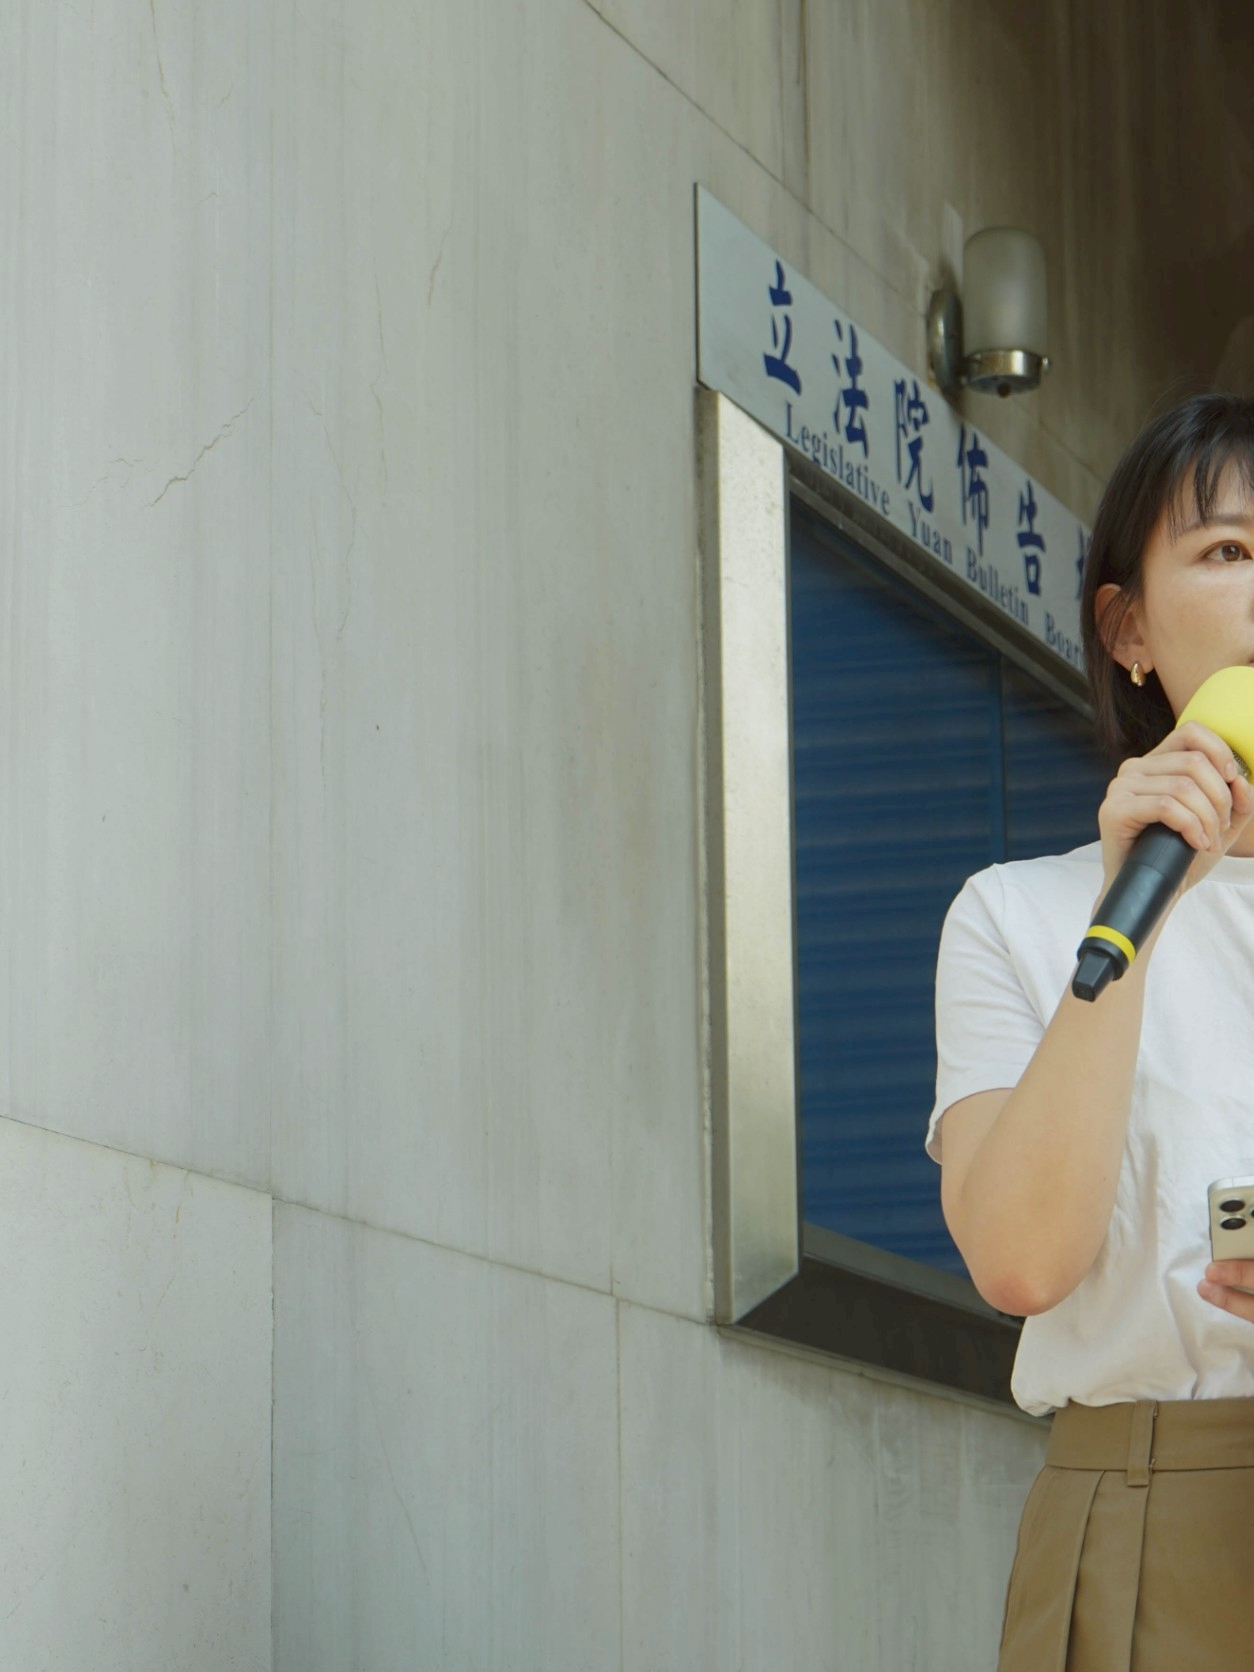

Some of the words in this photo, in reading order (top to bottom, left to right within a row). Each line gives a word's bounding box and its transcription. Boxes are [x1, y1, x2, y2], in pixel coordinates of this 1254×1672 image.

[785, 401, 890, 516] Legislative
[908, 501, 953, 565] Yuan
[966, 546, 1029, 626] Bulletin
